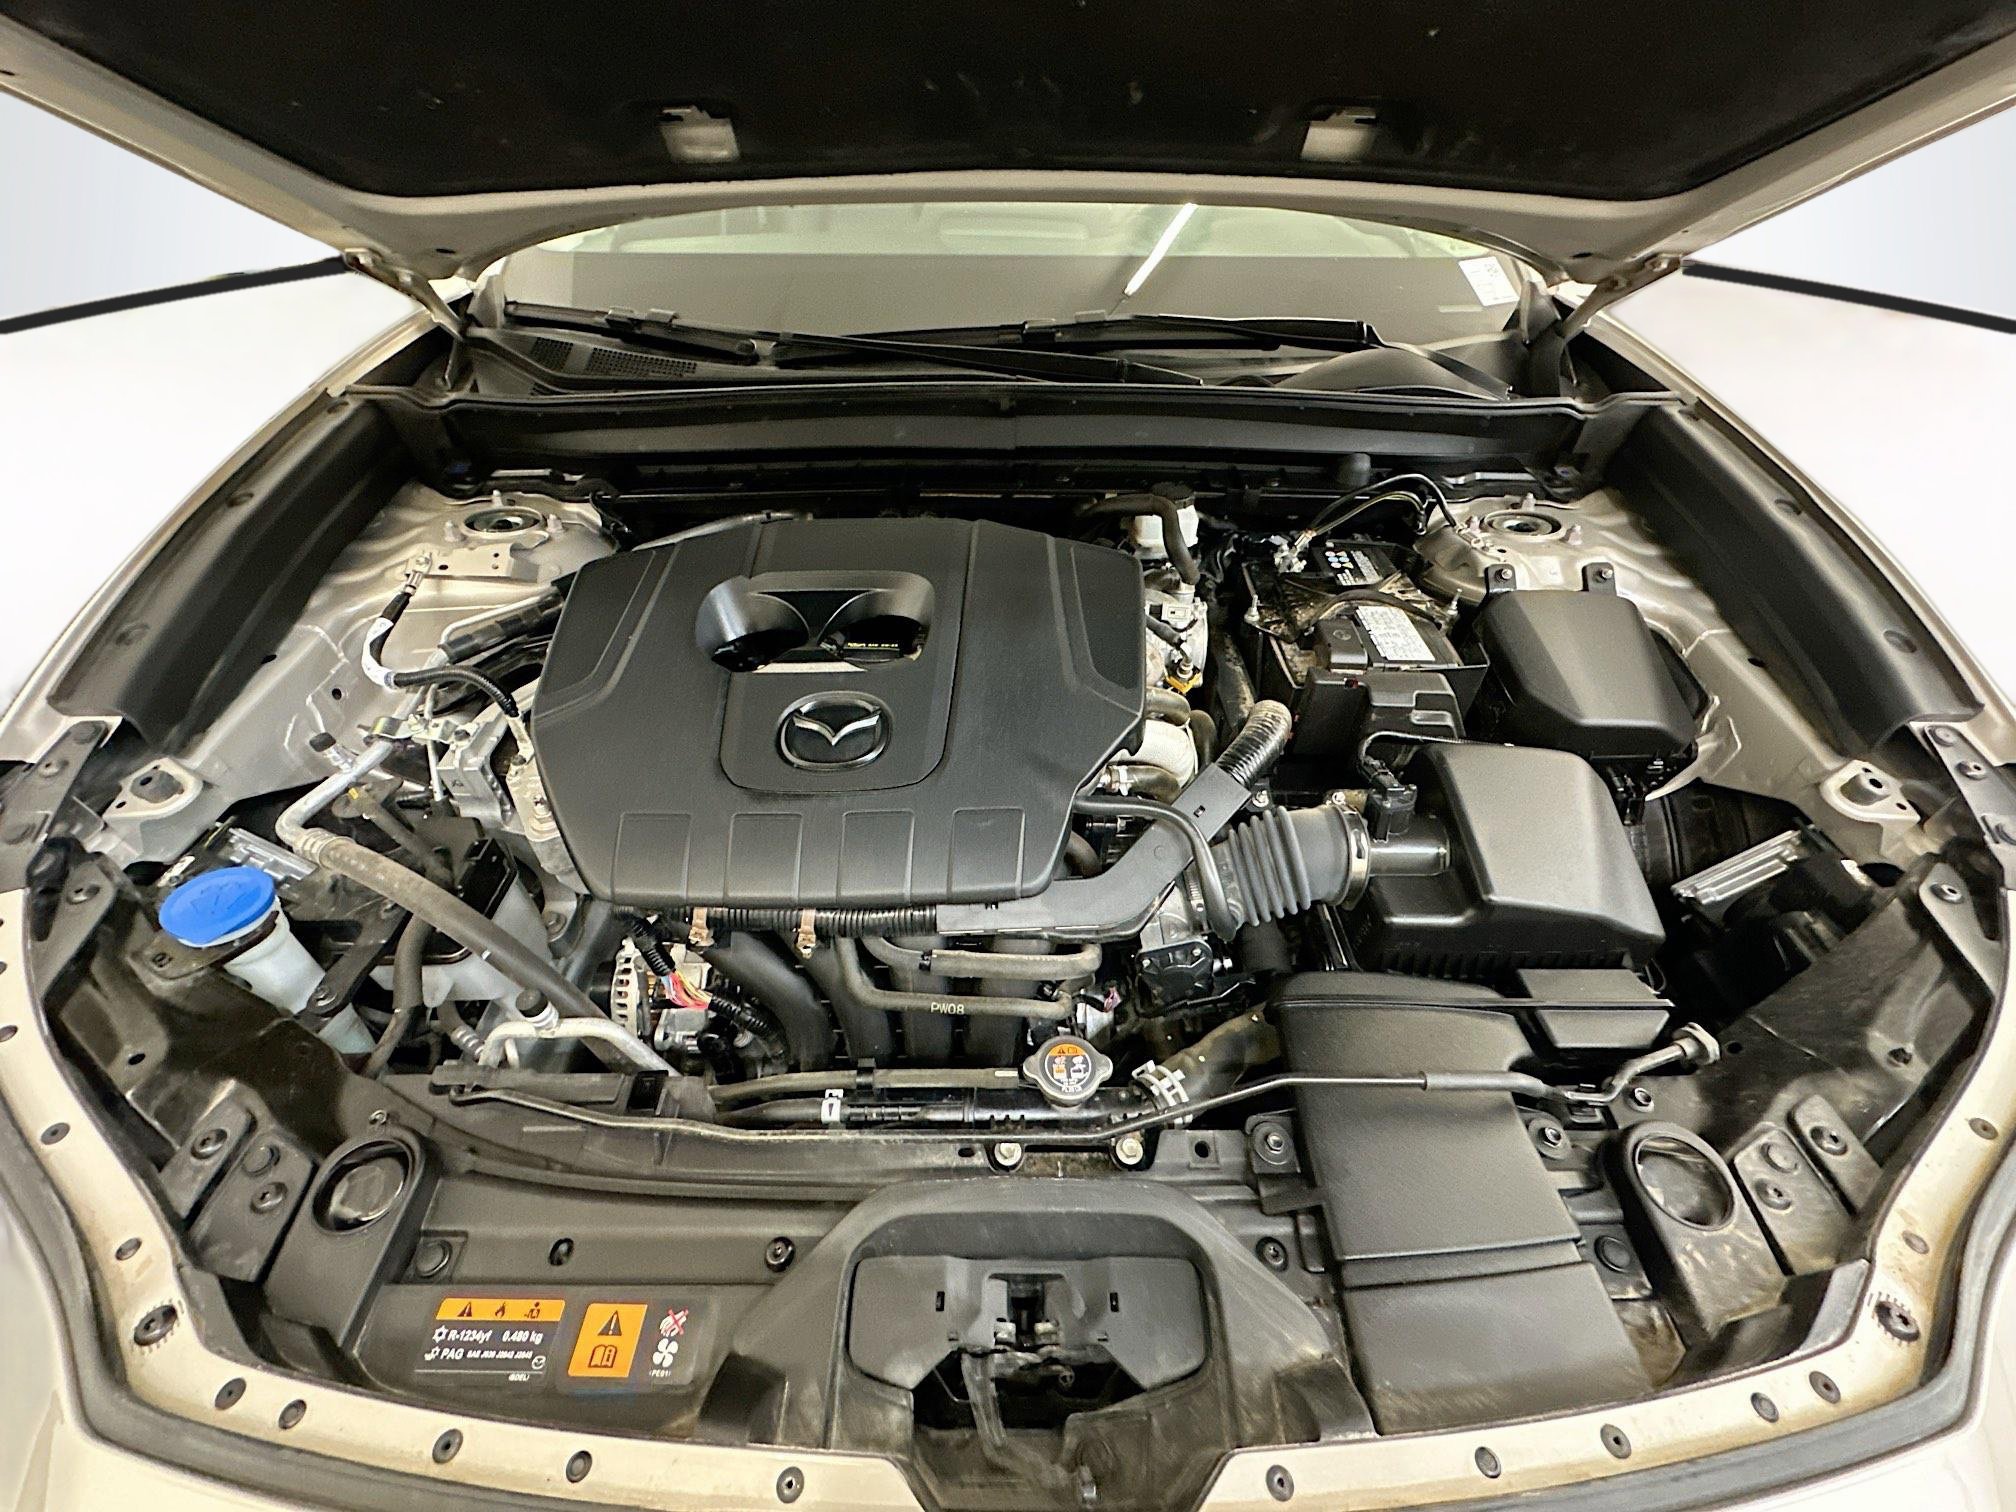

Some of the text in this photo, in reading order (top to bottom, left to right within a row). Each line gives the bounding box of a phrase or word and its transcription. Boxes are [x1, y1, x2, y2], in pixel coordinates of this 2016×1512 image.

[930, 1001, 965, 1015] PW08
[447, 1329, 493, 1344] R-1234yf
[529, 1330, 544, 1345] kg
[440, 1348, 464, 1360] PAG
